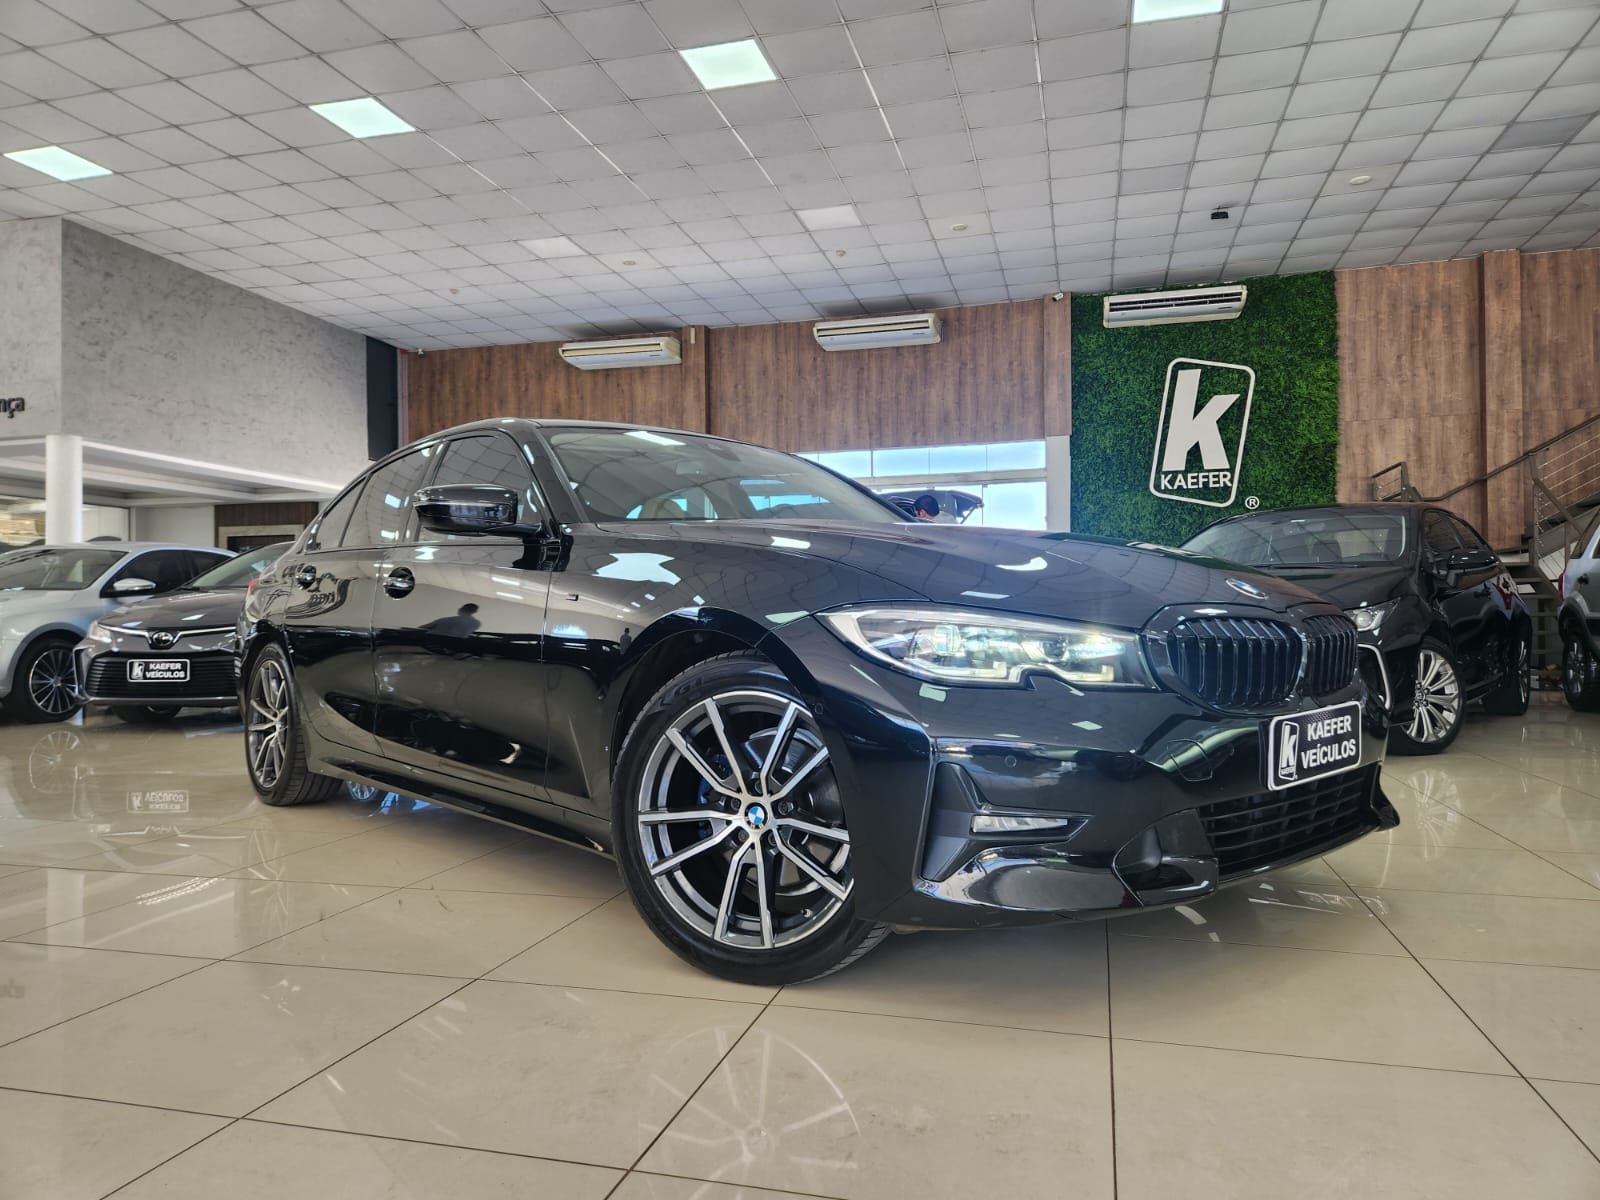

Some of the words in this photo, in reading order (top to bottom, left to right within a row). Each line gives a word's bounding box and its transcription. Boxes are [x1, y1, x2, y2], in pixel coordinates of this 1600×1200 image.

[1161, 471, 1232, 490] KAEFER
[149, 662, 182, 670] KAEFER
[1307, 715, 1352, 742] KAEFER
